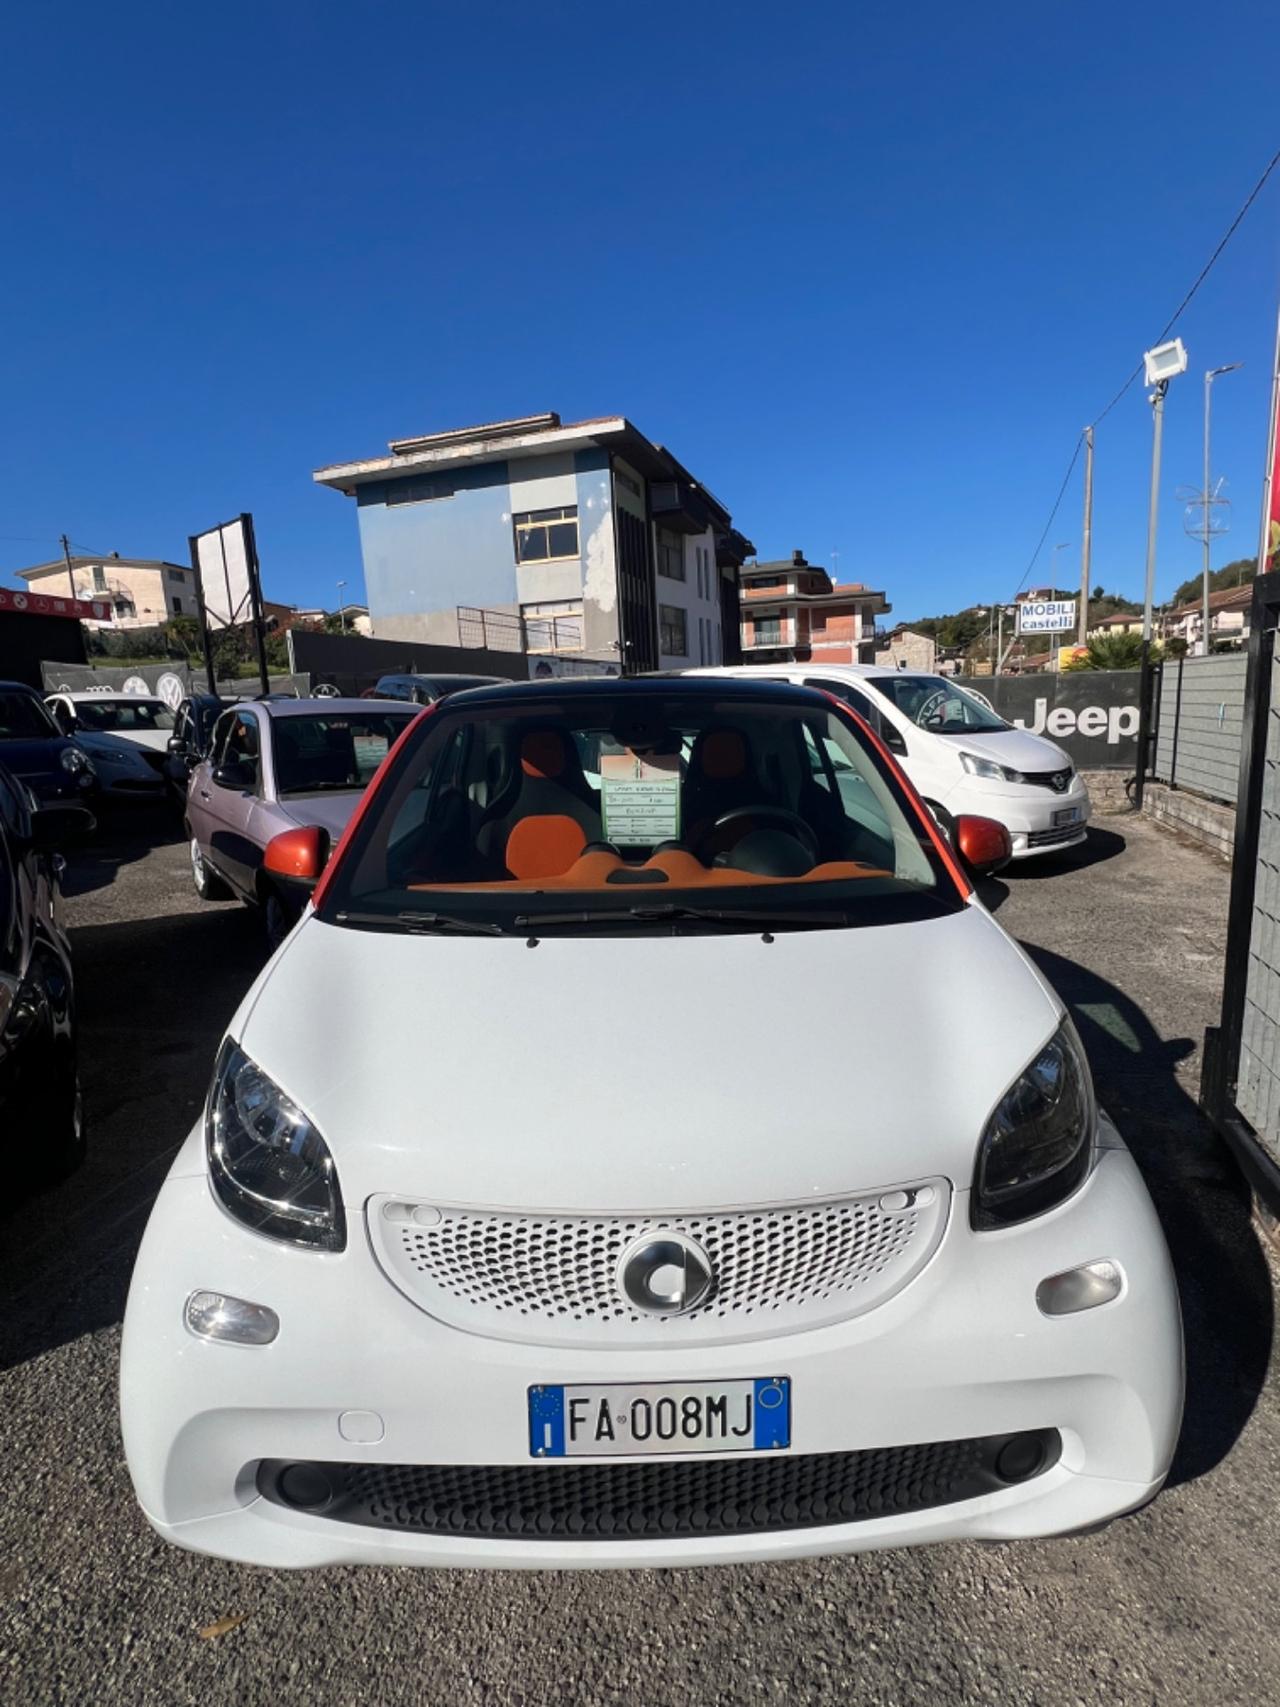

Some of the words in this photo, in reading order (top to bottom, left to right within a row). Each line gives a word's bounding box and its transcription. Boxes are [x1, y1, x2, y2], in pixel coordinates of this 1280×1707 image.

[1022, 602, 1074, 616] MOBILI
[1022, 616, 1073, 629] castelli
[1014, 697, 1140, 745] Jeep
